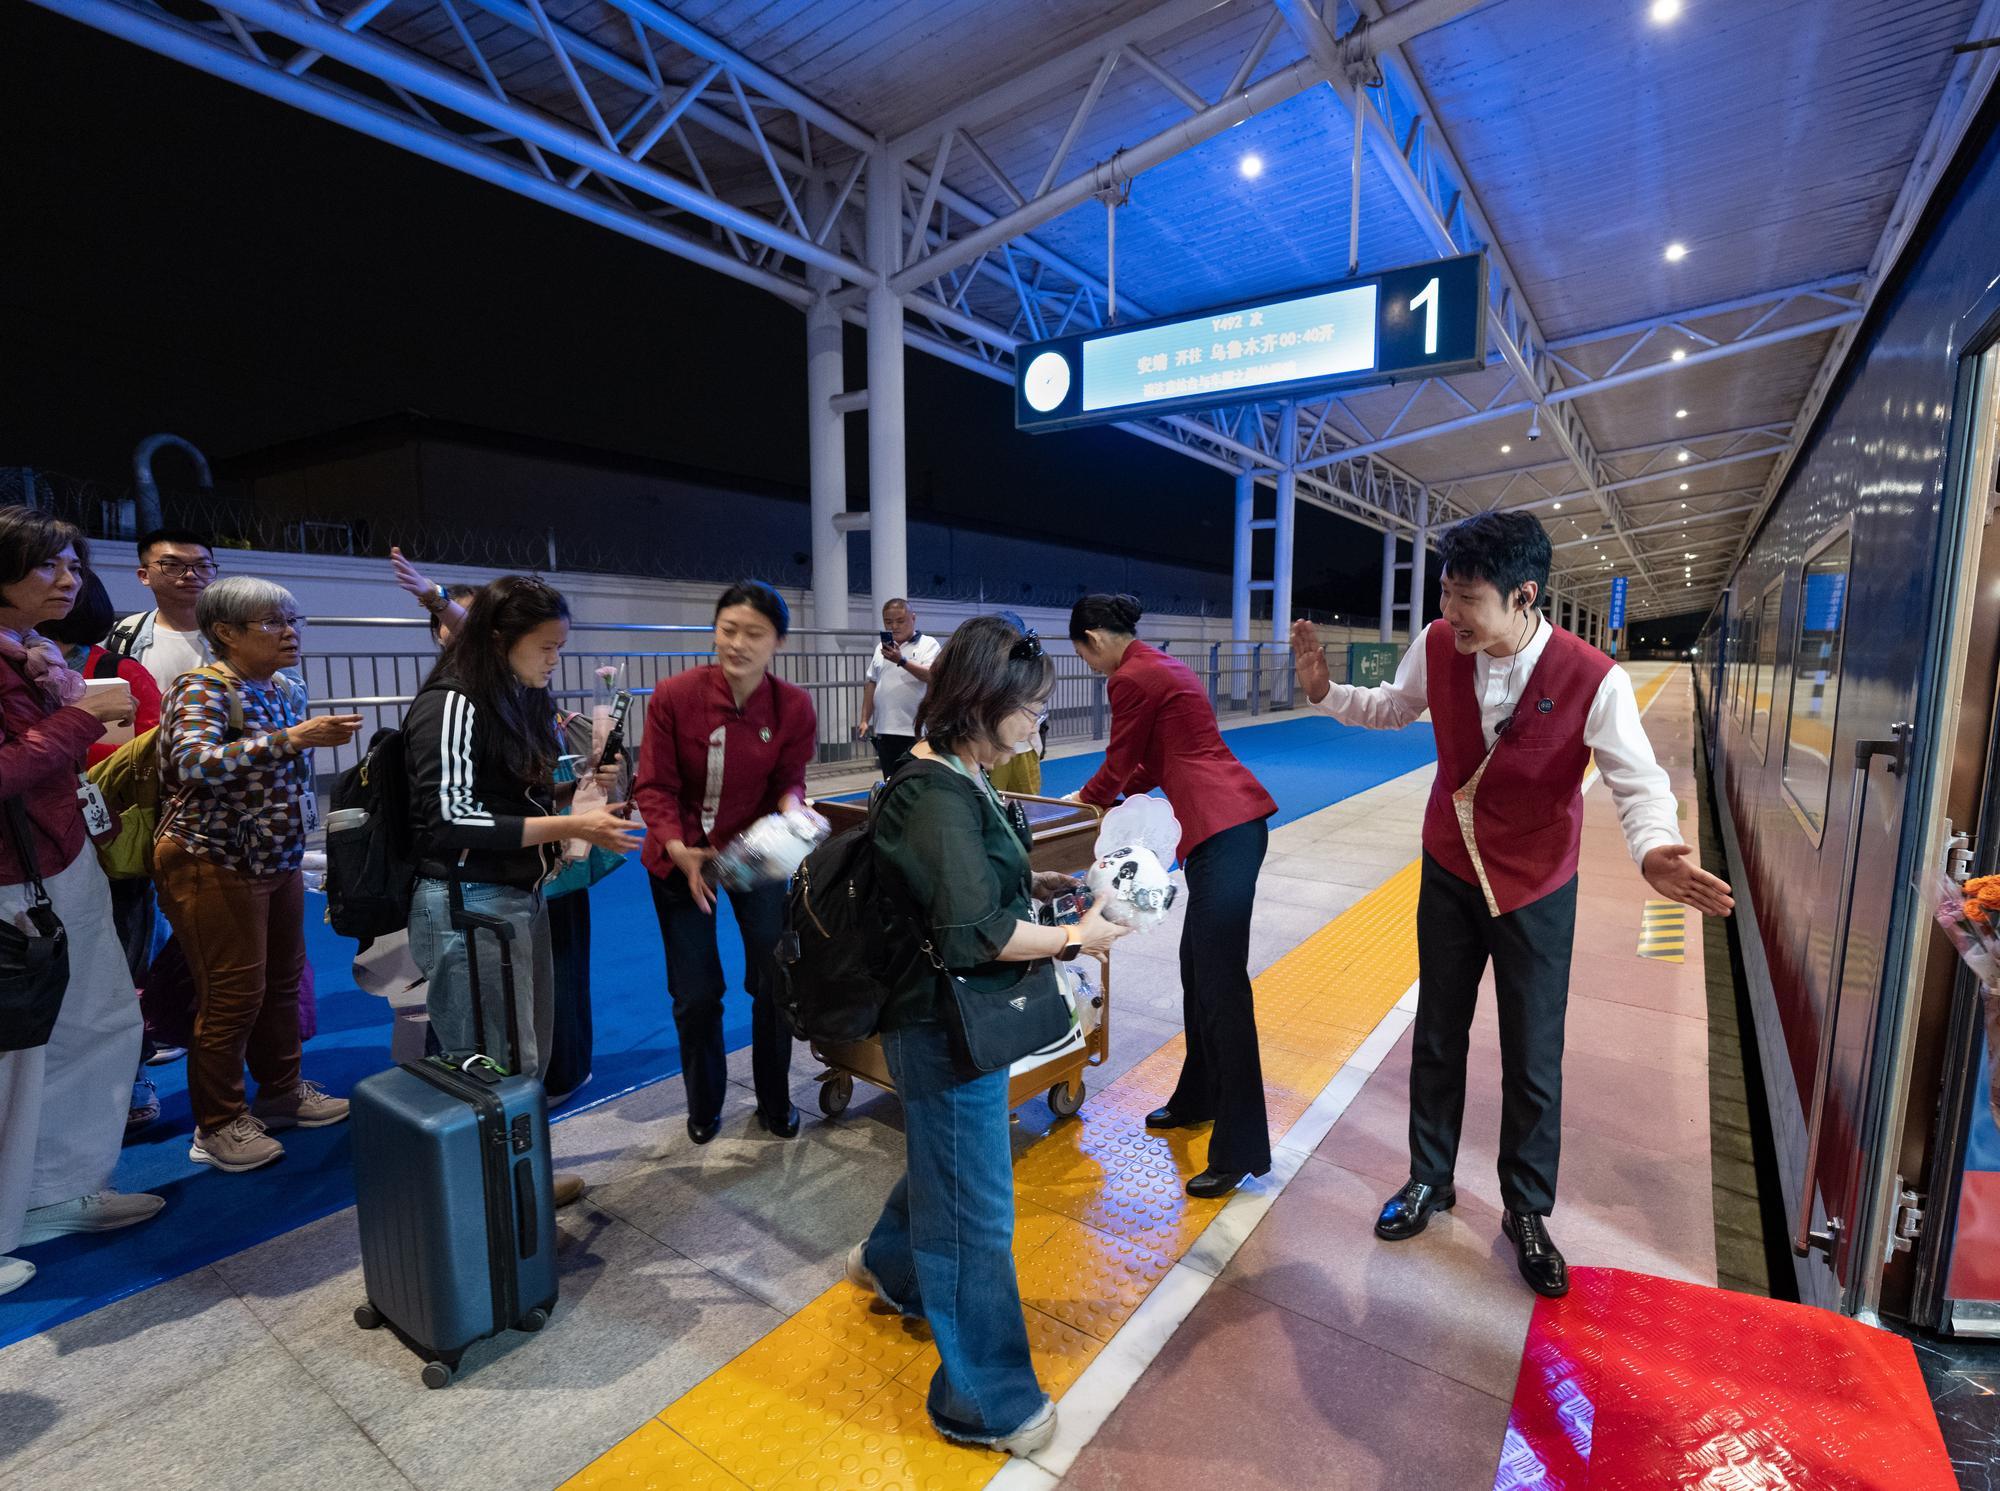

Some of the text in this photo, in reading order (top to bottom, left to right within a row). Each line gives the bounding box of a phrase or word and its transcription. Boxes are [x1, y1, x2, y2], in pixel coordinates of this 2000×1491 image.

[1211, 316, 1243, 333] Y492
[1409, 277, 1439, 355] 1
[1174, 347, 1203, 367] 开往
